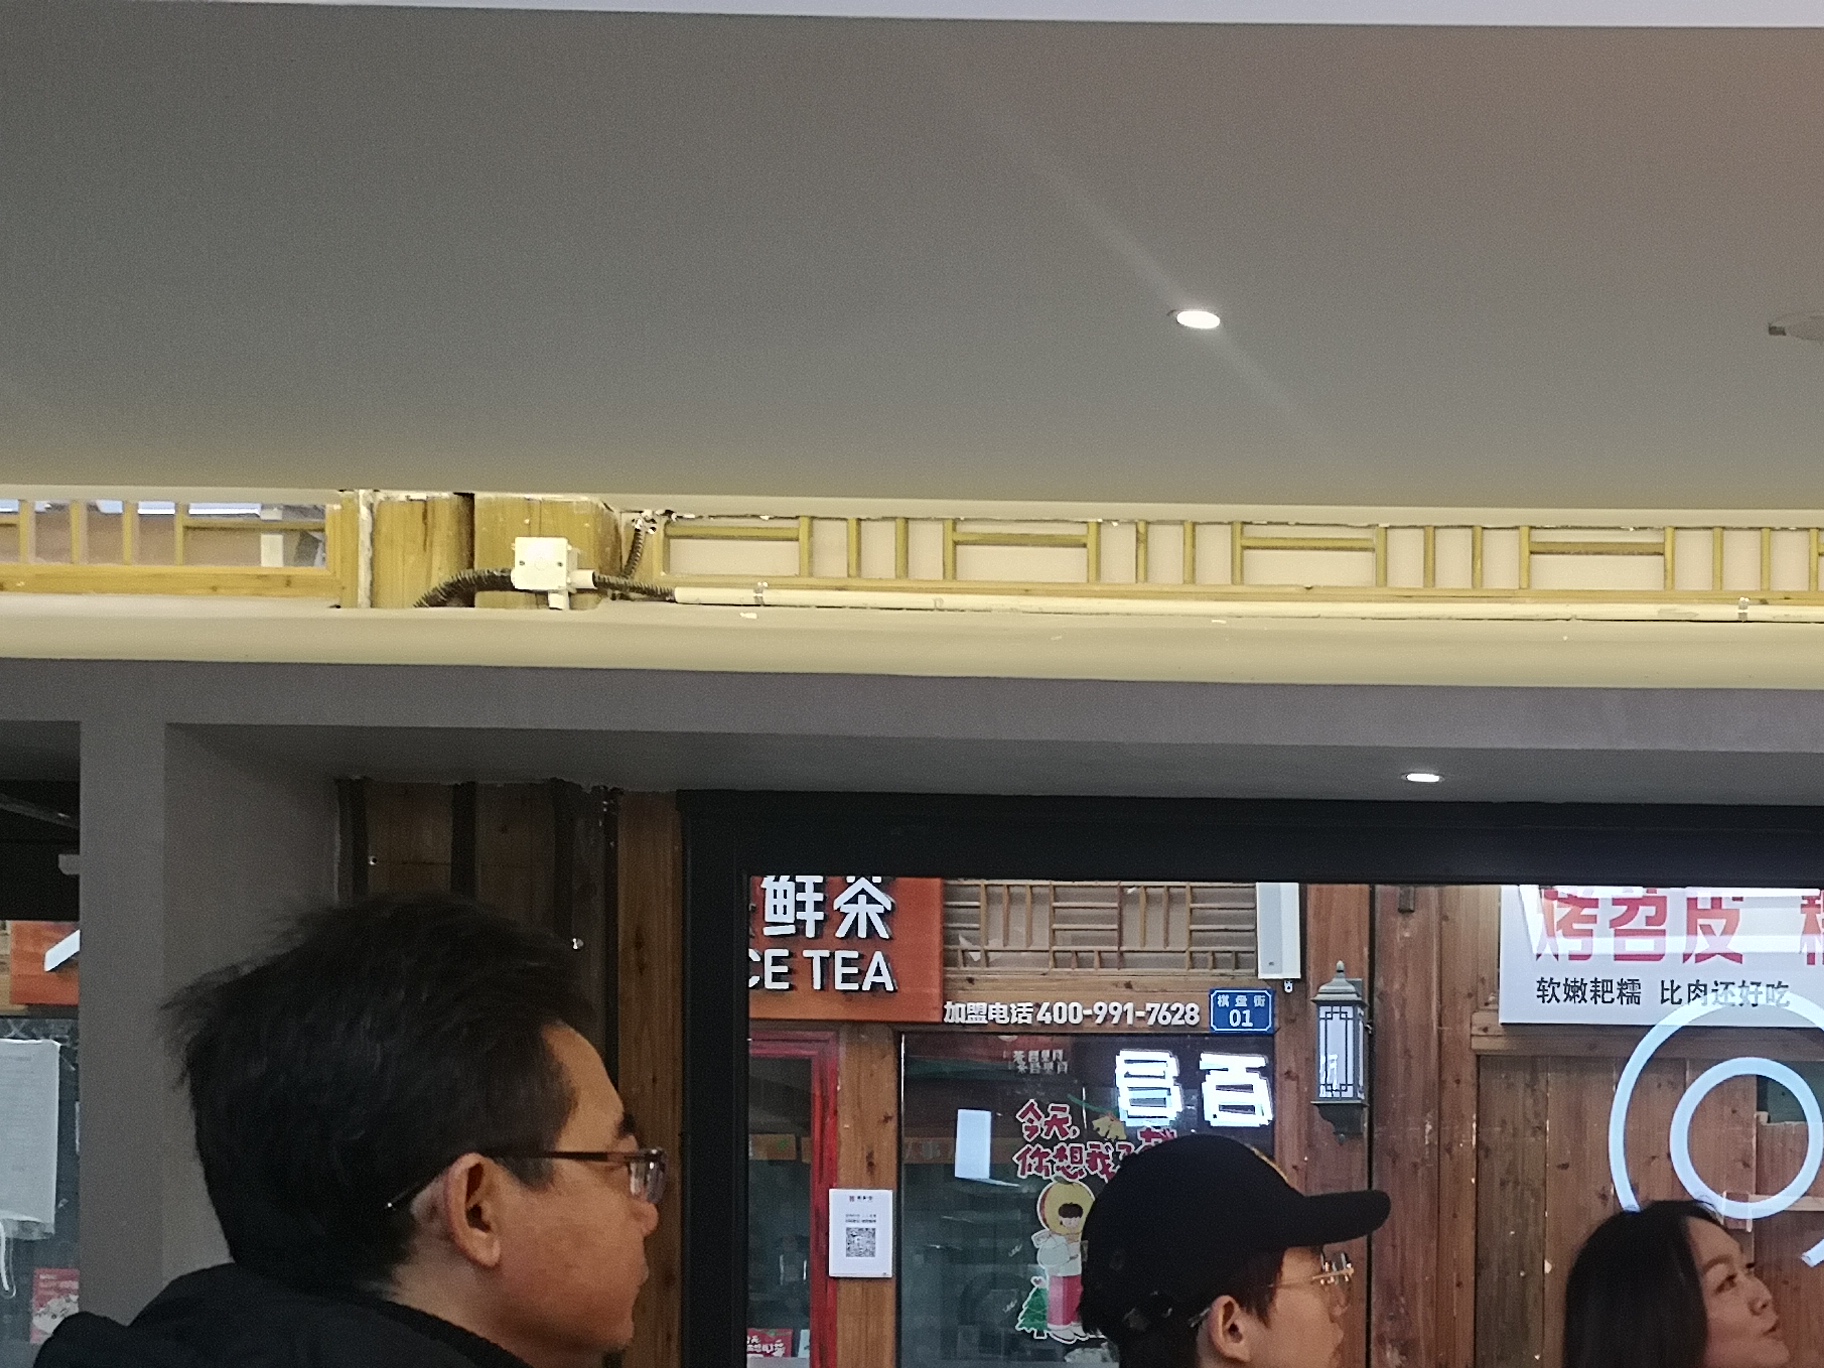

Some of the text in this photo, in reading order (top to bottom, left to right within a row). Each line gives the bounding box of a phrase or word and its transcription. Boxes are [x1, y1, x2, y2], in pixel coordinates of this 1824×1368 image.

[802, 949, 896, 992] TEA
[944, 1001, 1200, 1026] 加盟电话 400-991-7628
[1229, 1009, 1254, 1027] 01
